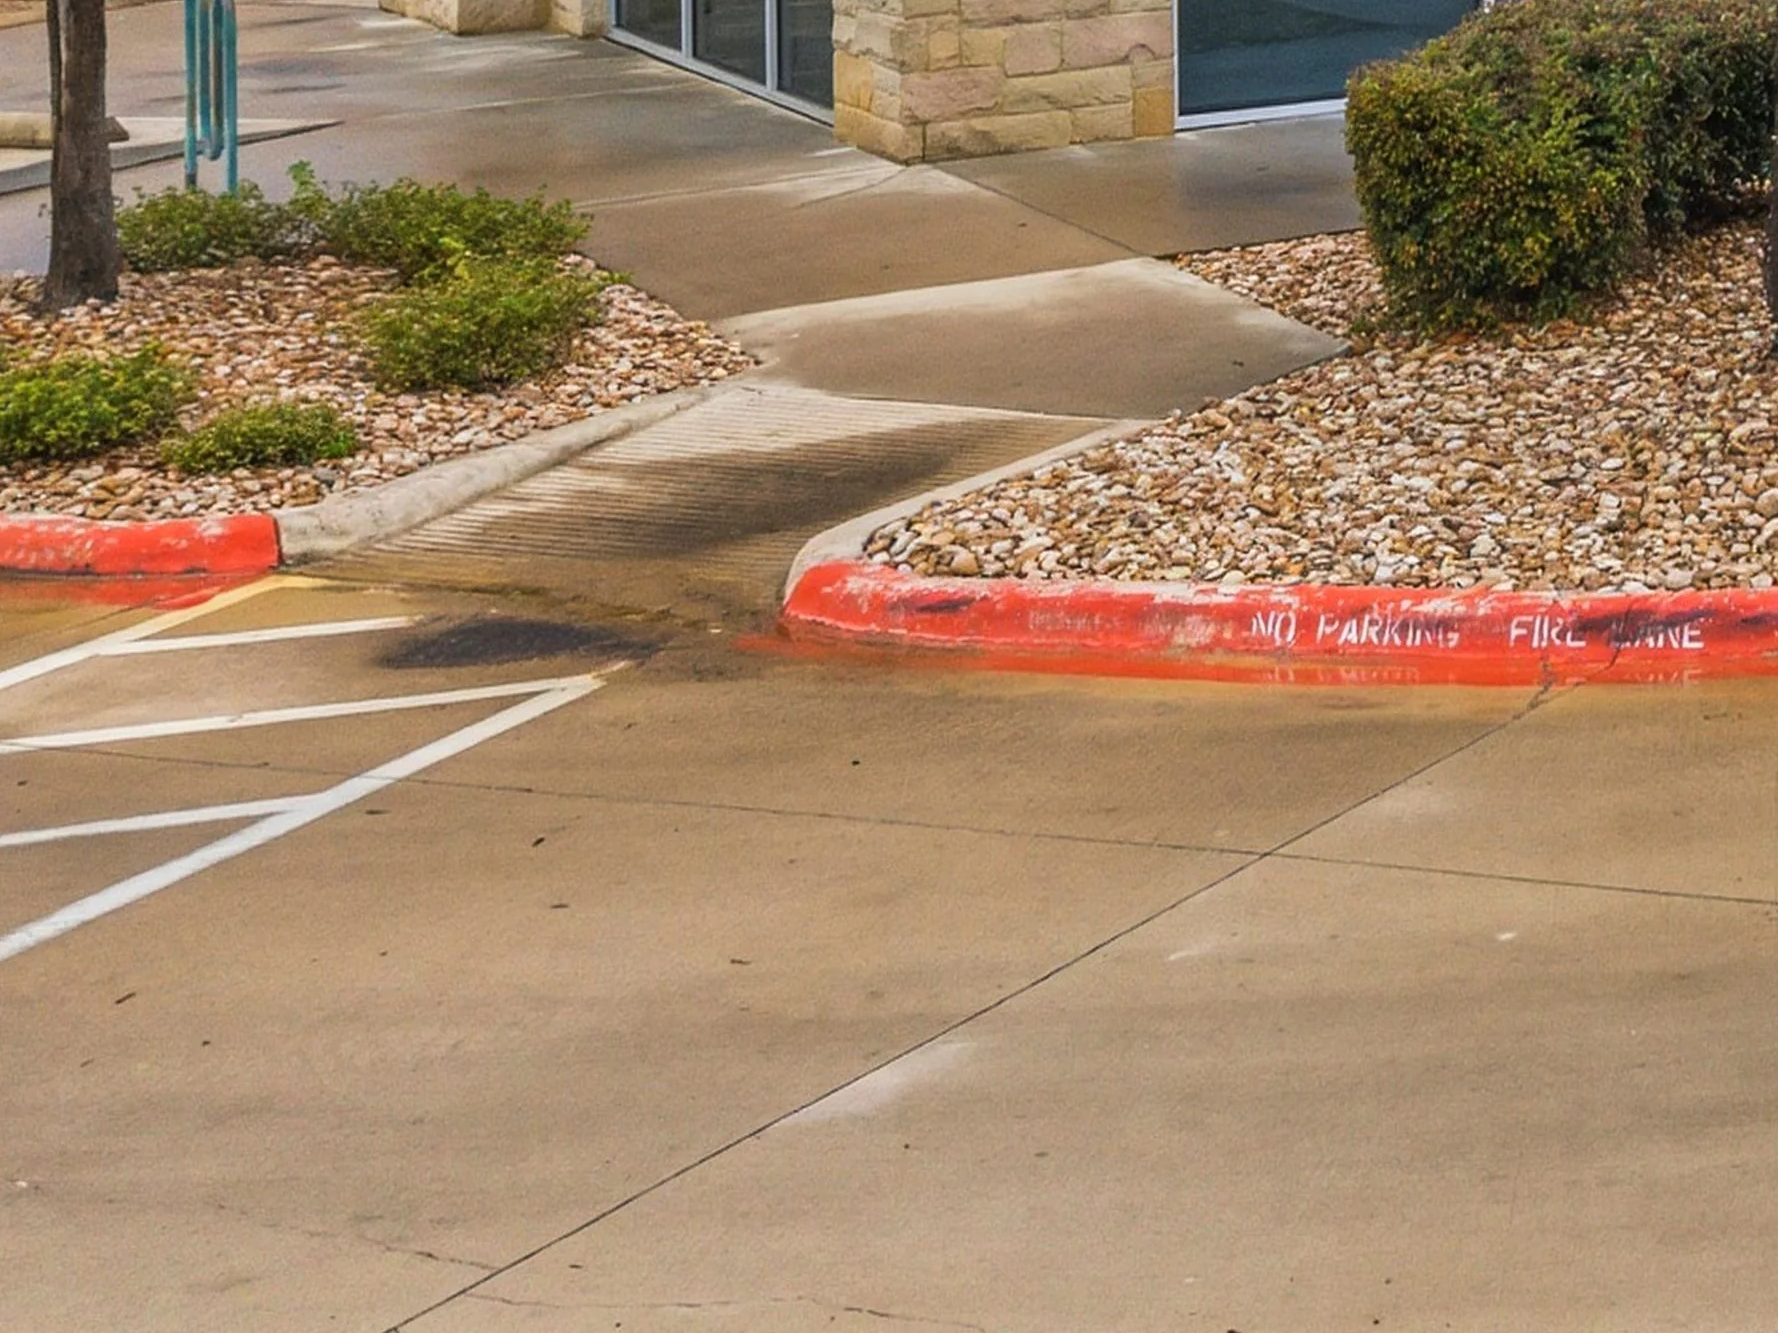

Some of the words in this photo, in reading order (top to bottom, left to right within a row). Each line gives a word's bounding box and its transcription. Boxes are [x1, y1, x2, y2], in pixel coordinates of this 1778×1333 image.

[1250, 610, 1296, 647] NO
[1316, 611, 1461, 648] PARKING
[1509, 614, 1588, 649] FIRE
